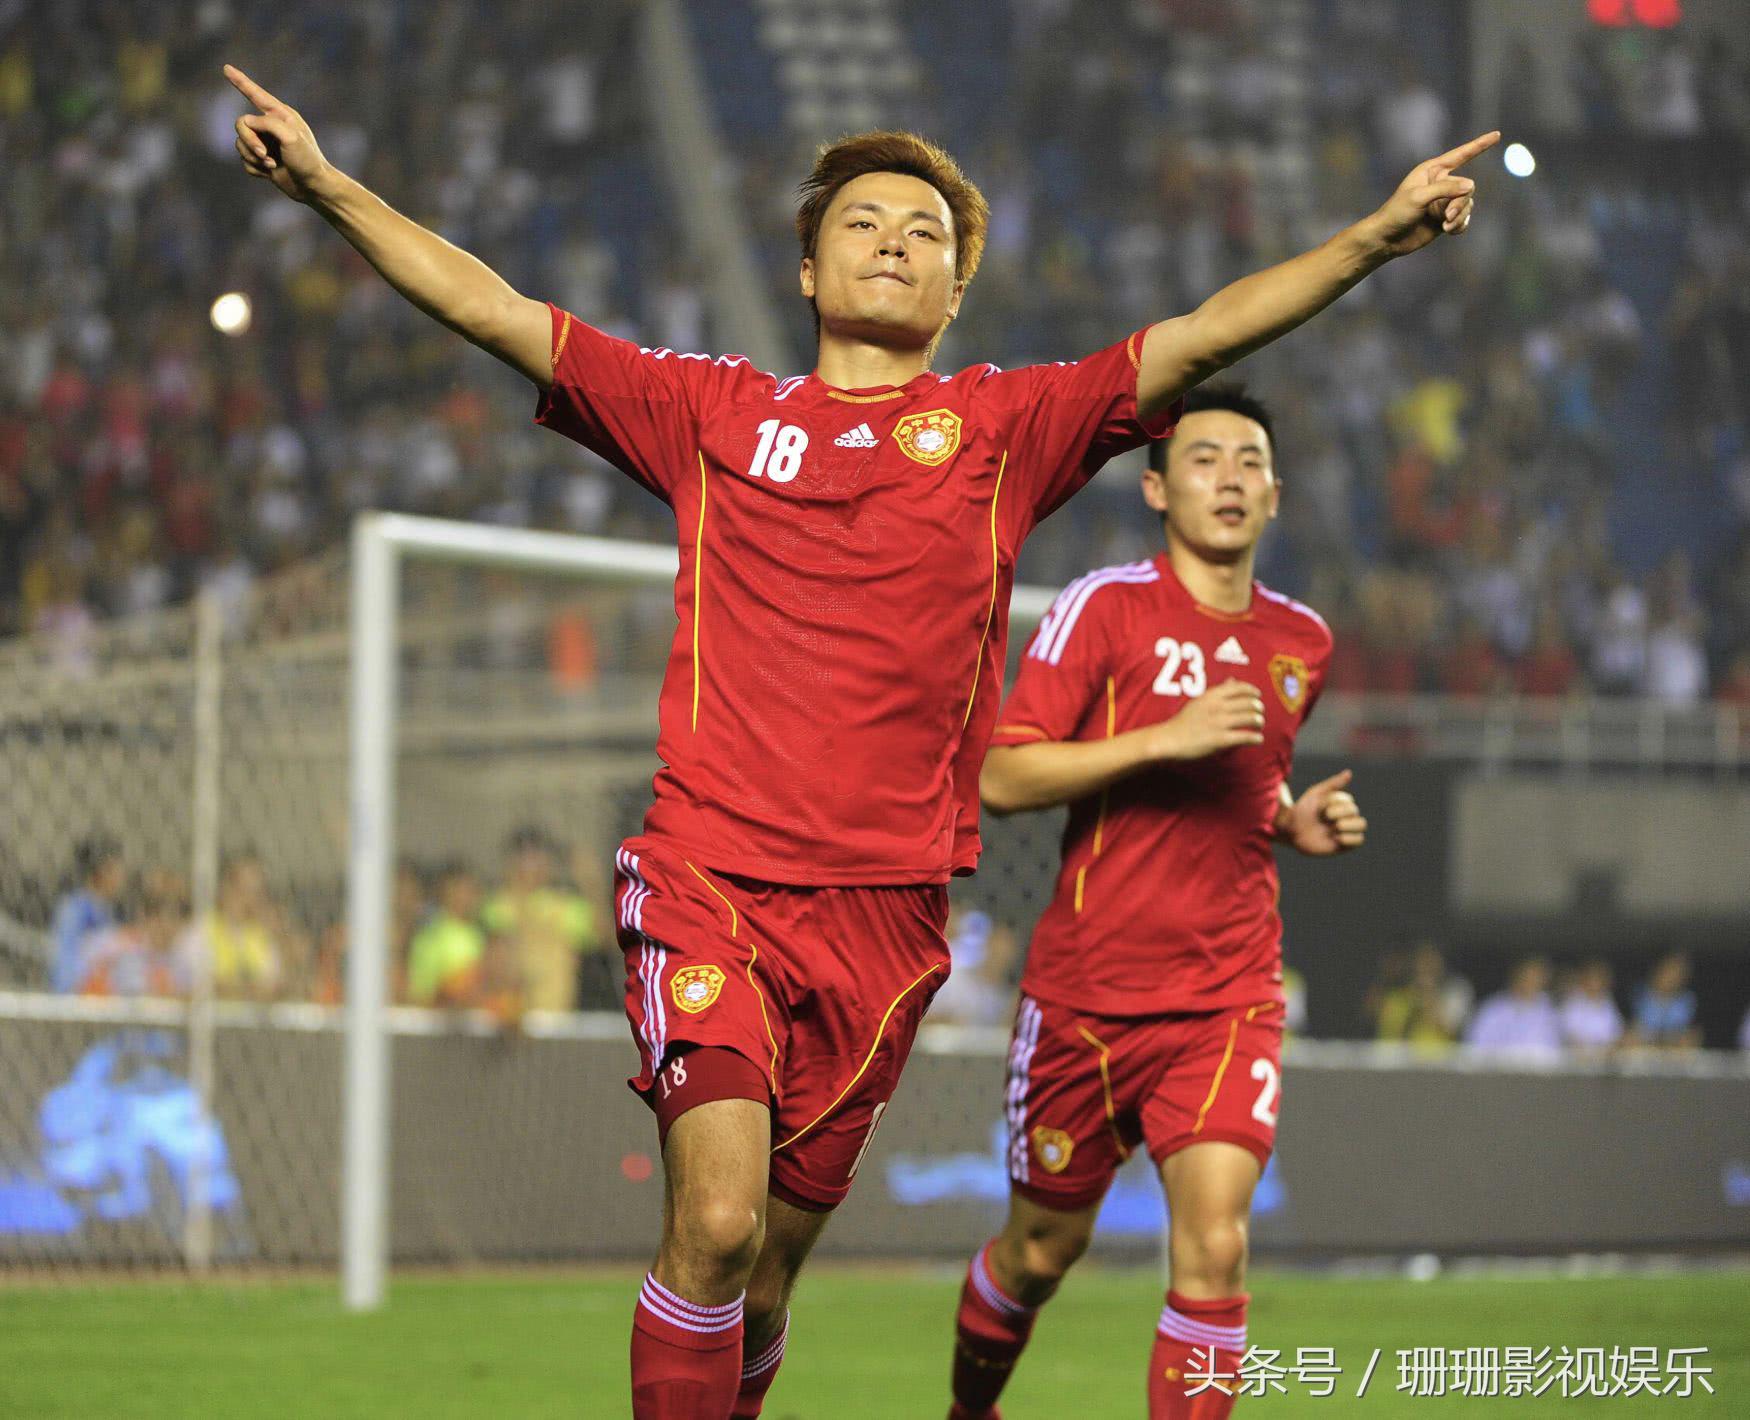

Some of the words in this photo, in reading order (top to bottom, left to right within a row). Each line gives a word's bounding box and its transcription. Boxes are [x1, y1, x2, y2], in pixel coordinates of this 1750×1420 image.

[748, 420, 808, 482] 18
[834, 437, 880, 448] adidas
[1154, 638, 1205, 696] 23
[659, 1056, 687, 1100] 18
